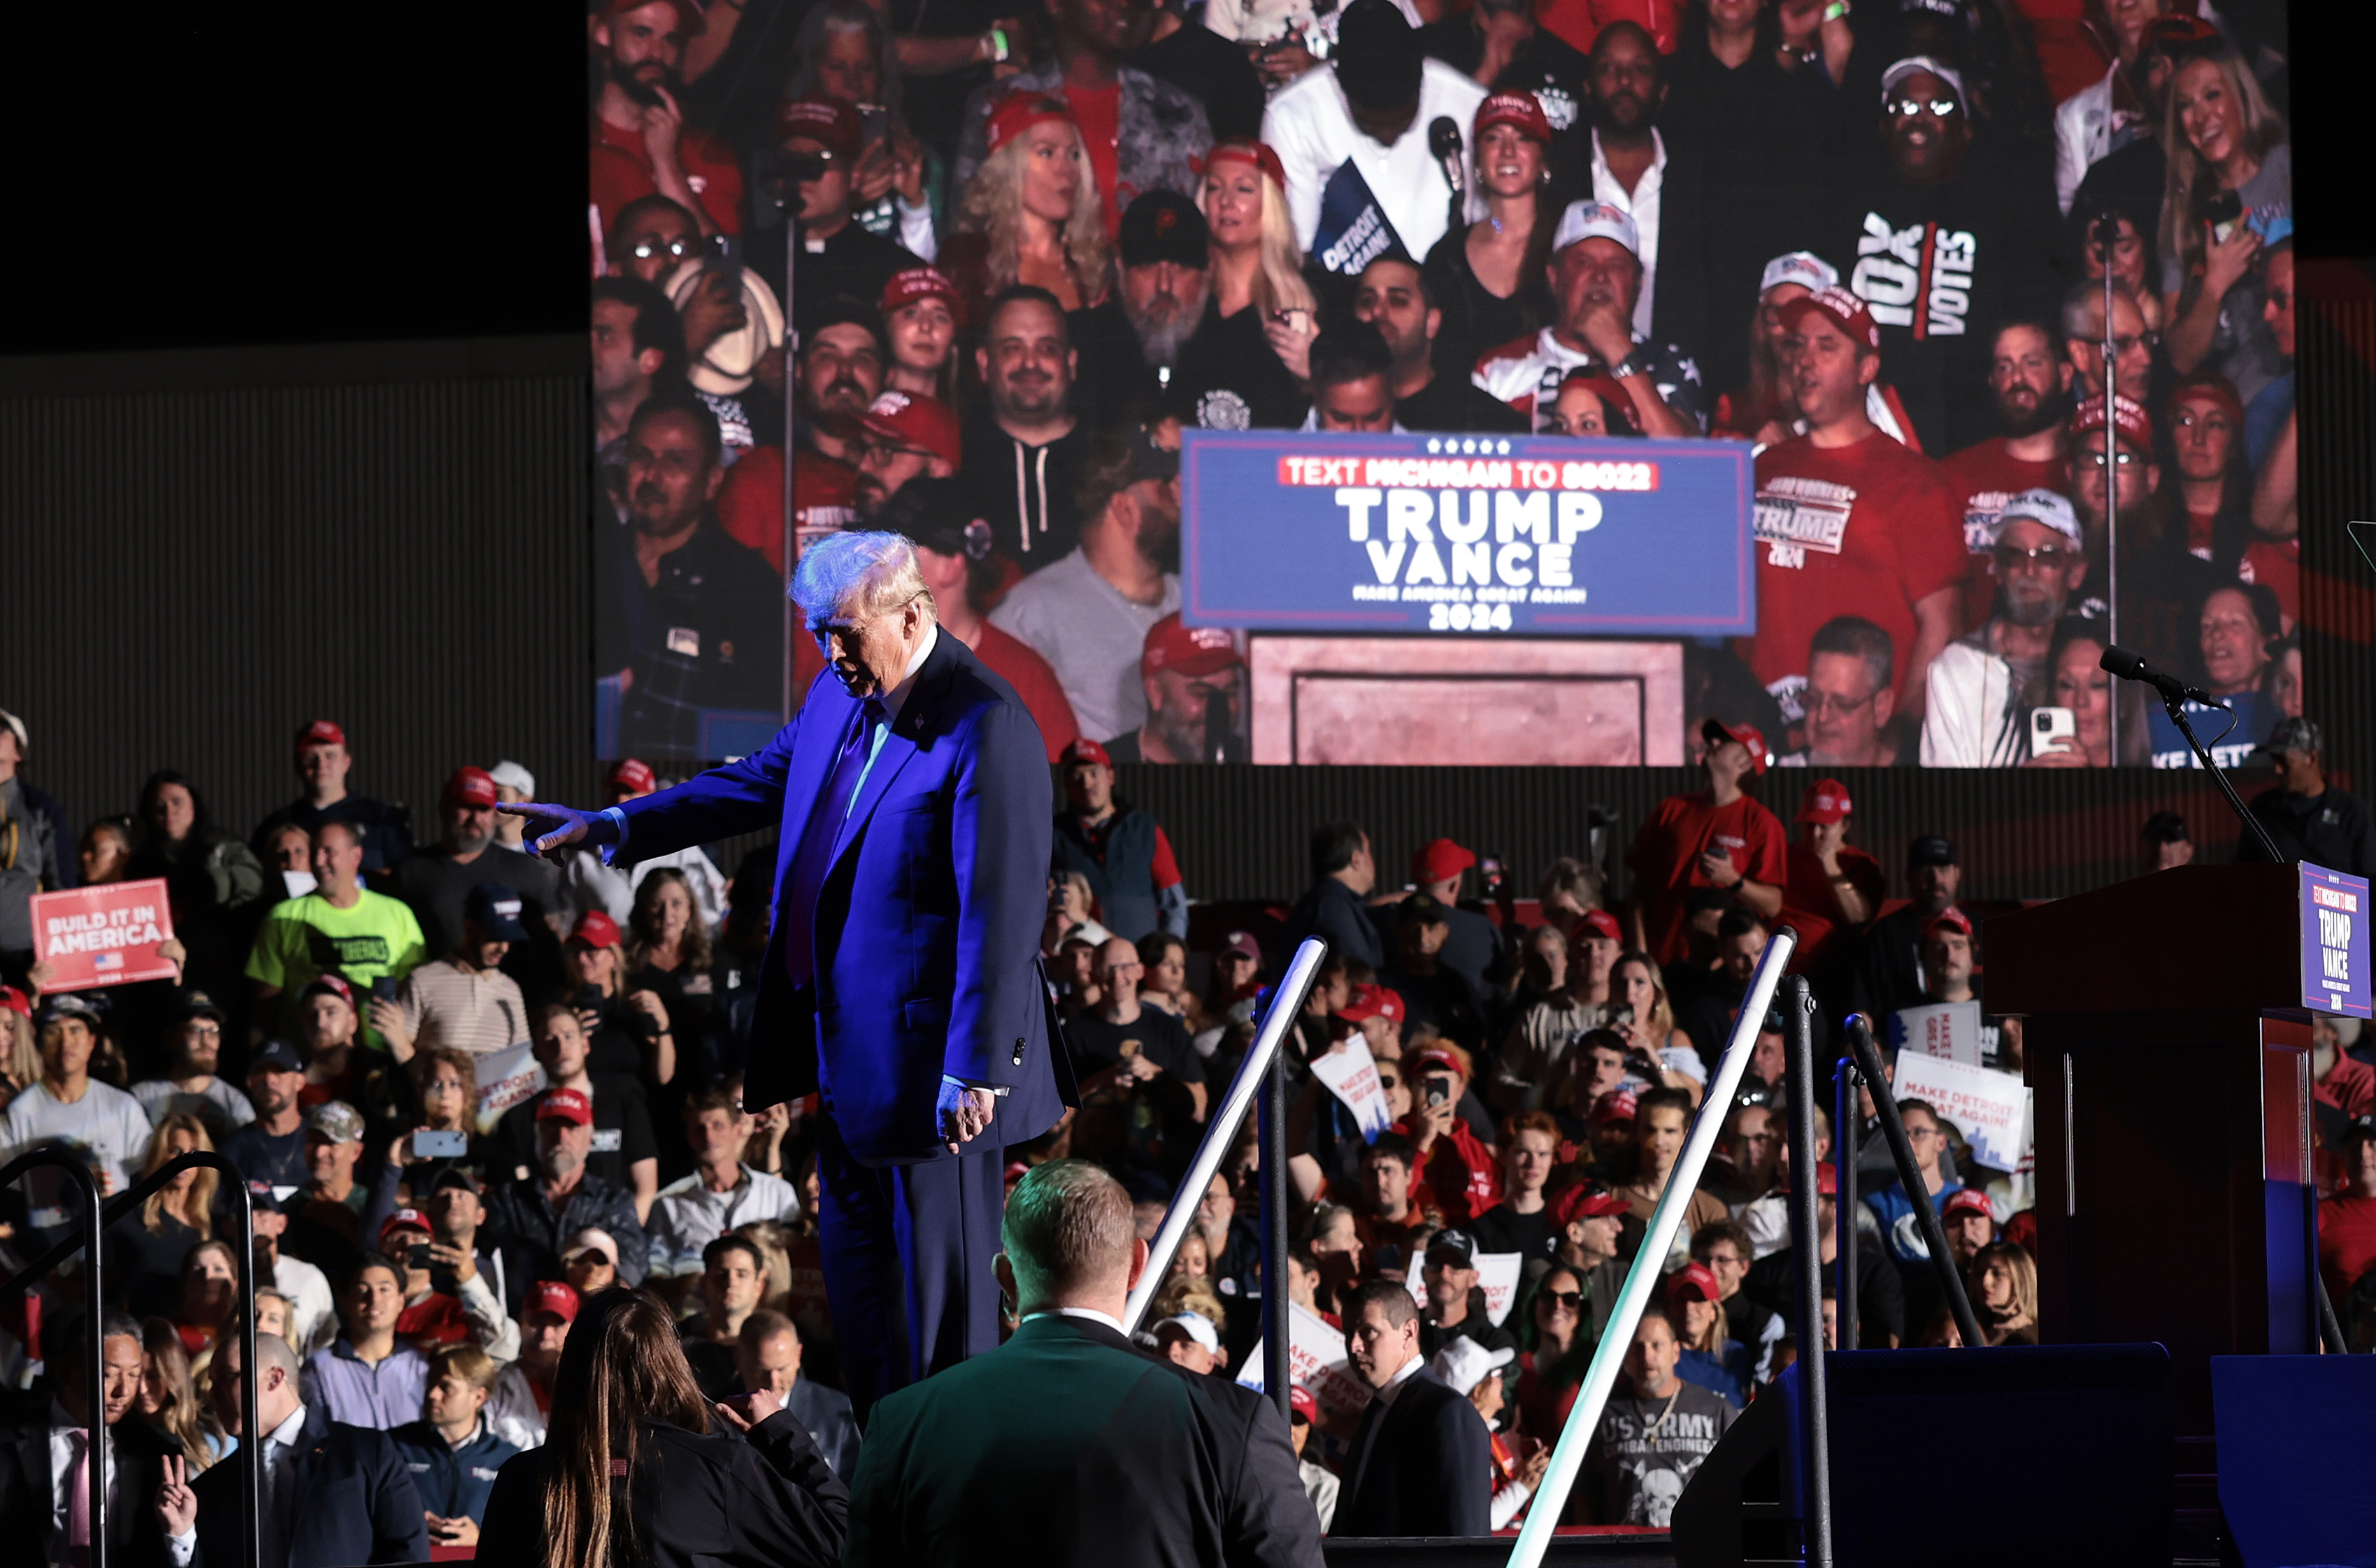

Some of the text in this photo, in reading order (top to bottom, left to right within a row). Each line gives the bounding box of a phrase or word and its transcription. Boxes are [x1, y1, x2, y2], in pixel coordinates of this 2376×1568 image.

[1322, 203, 1380, 273] DETROIT
[1851, 210, 1924, 326] 10X
[1928, 228, 1977, 336] VOTES
[1287, 458, 1652, 490] TEXT MICHIGAN TO 88022
[1335, 487, 1603, 545] TRUMP
[1753, 503, 1840, 540] TRUMP
[1366, 540, 1573, 587] VANCE
[1401, 586, 1473, 603] AMERICA
[1475, 587, 1527, 603] GREAT
[1429, 603, 1512, 631] 2024
[47, 905, 156, 935] BUILD IT IN
[2319, 908, 2351, 950] TRUMP
[48, 923, 162, 957] AMERICA
[2322, 947, 2349, 980] VANCE
[1904, 1081, 2012, 1116] MAKE DETROIT
[1959, 1108, 2008, 1128] AGAIN!
[1289, 1344, 1318, 1368] AKE
[1289, 1362, 1317, 1386] EAT
[1601, 1411, 1714, 1443] US ARMY
